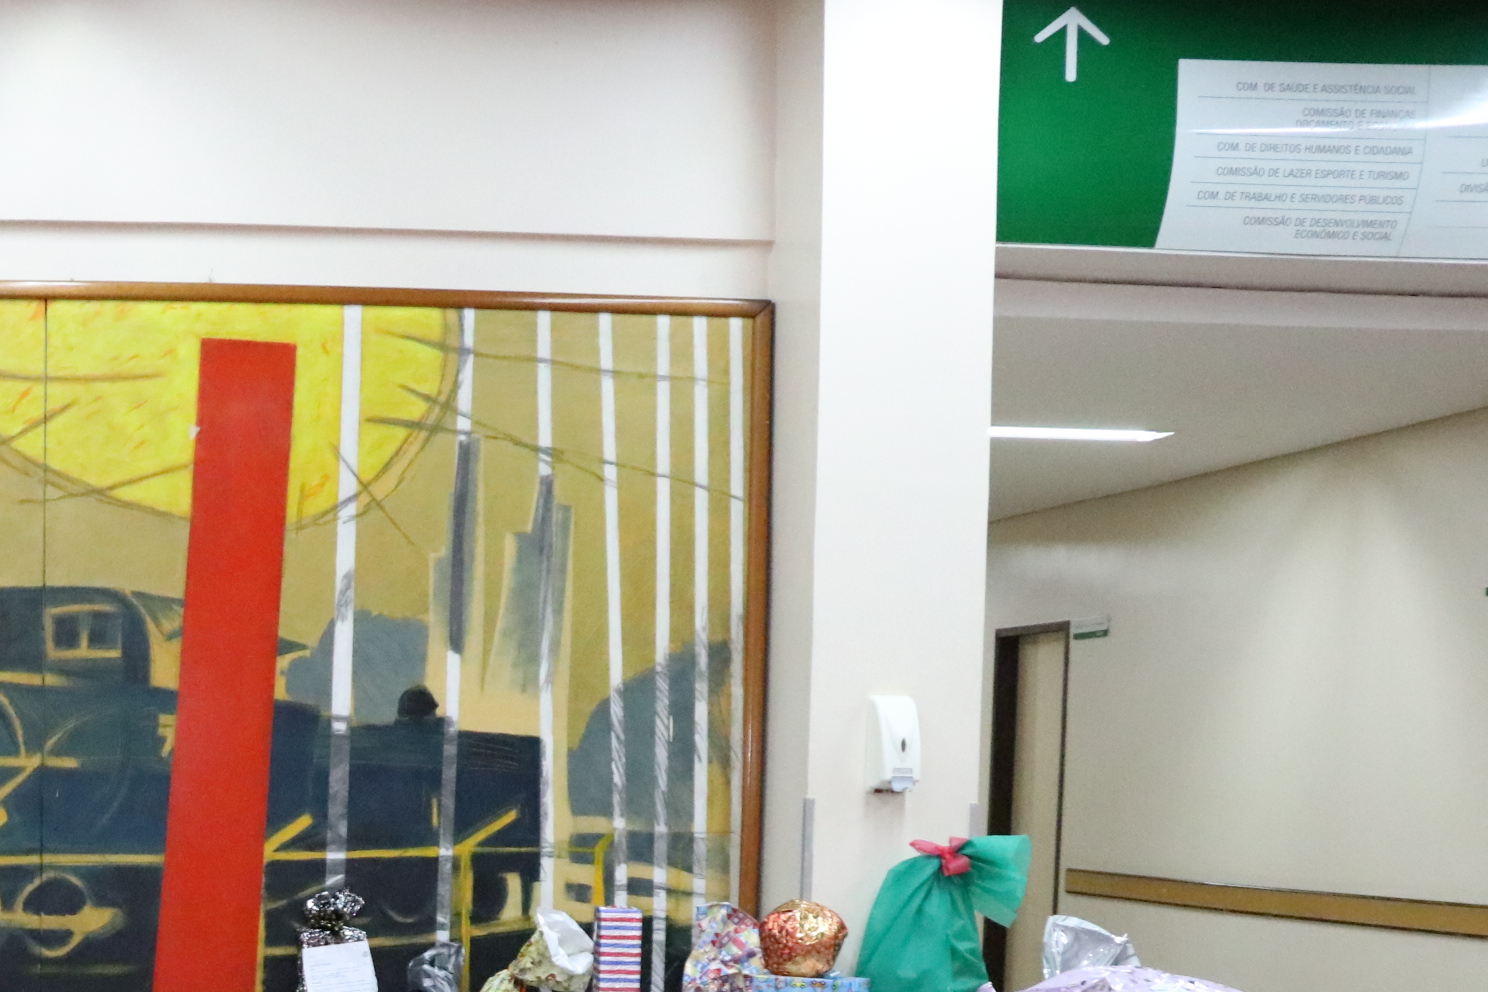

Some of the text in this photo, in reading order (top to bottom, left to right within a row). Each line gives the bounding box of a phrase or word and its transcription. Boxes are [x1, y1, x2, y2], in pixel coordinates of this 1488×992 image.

[1263, 82, 1276, 92] DE
[1279, 81, 1311, 93] SAÚDE
[1312, 83, 1319, 94] E
[1384, 85, 1416, 96] SOCIAL
[1302, 106, 1352, 118] COMISSÃO
[1355, 108, 1367, 118] DE
[1245, 142, 1257, 152] DE
[1259, 143, 1302, 154] DIREITOS
[1304, 144, 1352, 155] HUMANOS
[1354, 145, 1361, 155] E
[1363, 145, 1413, 156] CIDADANIA
[1216, 165, 1410, 181] COMISSÃO DE LAZER ESPORTE E TURISMO
[1224, 191, 1237, 201] DE
[1239, 191, 1288, 203] TRABALHO
[1290, 192, 1297, 203] E
[1298, 192, 1357, 204] SERVIDORES
[1358, 193, 1405, 206] PÚBLICOS
[1243, 214, 1398, 230] COMISSÃO DE DESENVOLVIMENTO
[1352, 230, 1359, 240] E
[1360, 230, 1393, 242] SOCIAL
